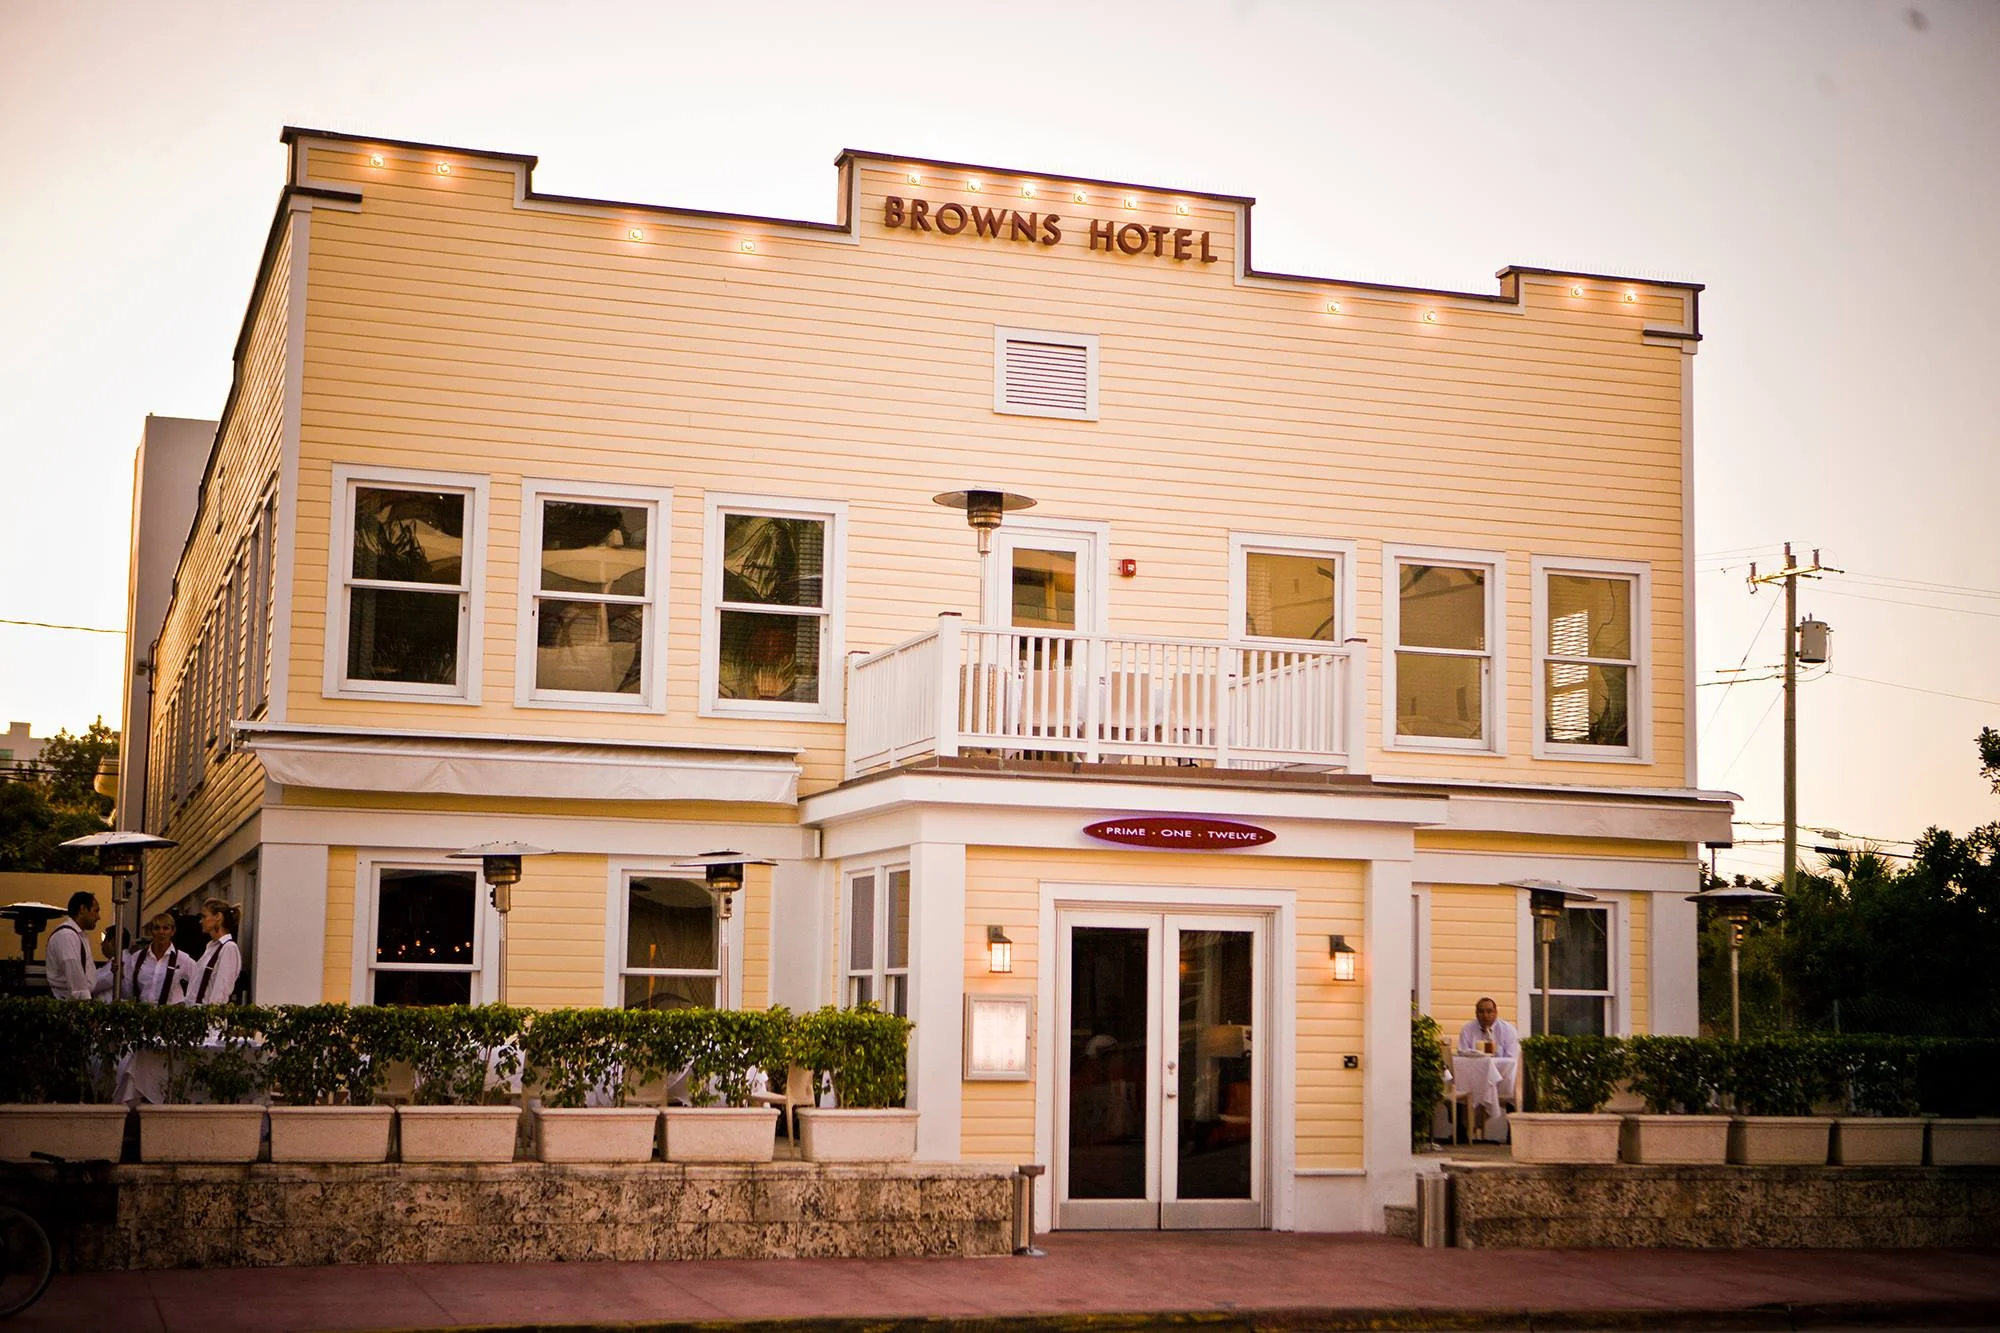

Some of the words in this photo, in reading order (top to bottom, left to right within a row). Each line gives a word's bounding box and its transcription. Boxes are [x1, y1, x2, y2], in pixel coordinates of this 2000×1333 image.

[884, 196, 1062, 246] BROWNS
[1089, 219, 1218, 263] HOTEL
[1106, 827, 1146, 836] PRIME
[1160, 829, 1192, 838] ONE
[1207, 830, 1257, 840] TWELVE
